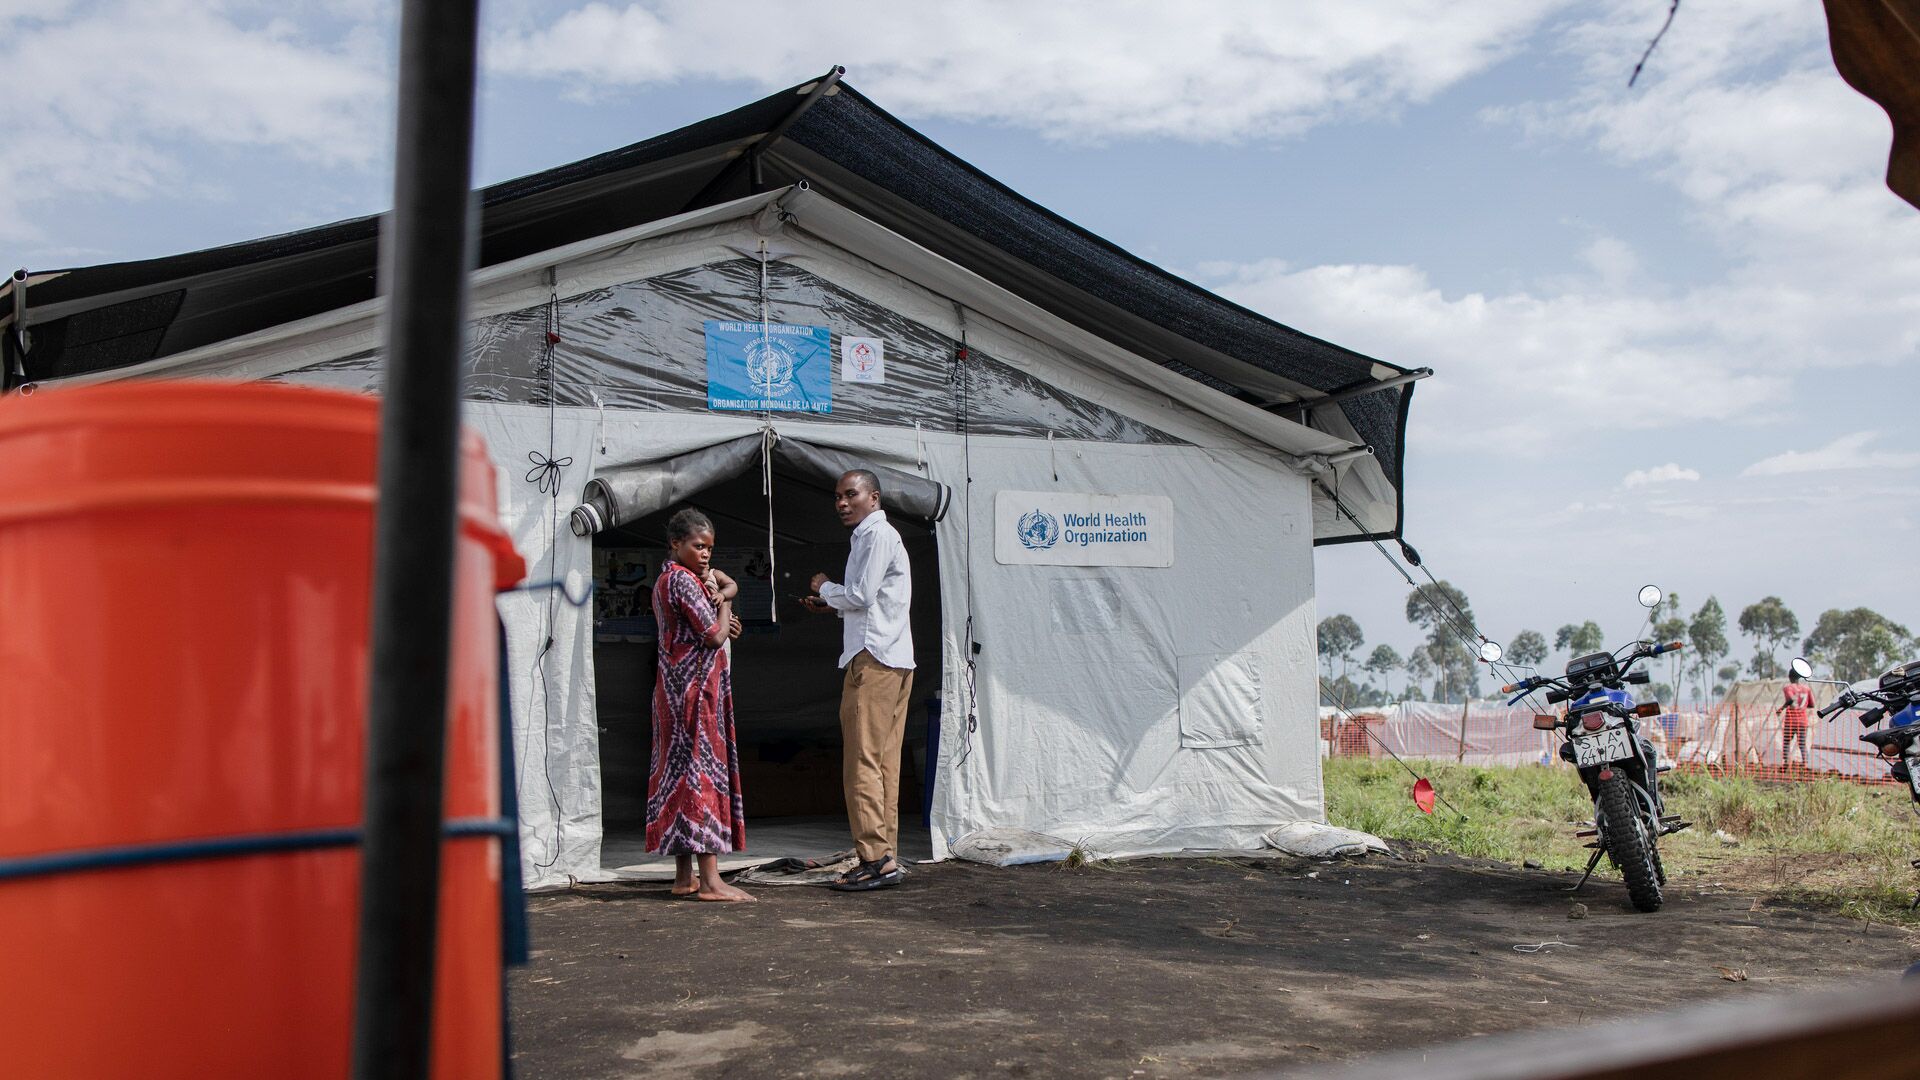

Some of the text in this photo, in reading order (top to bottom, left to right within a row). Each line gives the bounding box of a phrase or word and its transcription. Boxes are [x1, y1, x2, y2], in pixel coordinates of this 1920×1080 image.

[719, 322, 743, 333] WORLD
[769, 324, 814, 336] ORGANIZATION
[743, 336, 797, 355] EMERGECY RELIEF
[713, 398, 759, 409] ORGANISATION
[760, 399, 791, 410] MONDIALE
[792, 400, 801, 410] DE
[802, 400, 810, 410] LA
[1063, 512, 1147, 527] World Health
[1064, 528, 1147, 547] Organization
